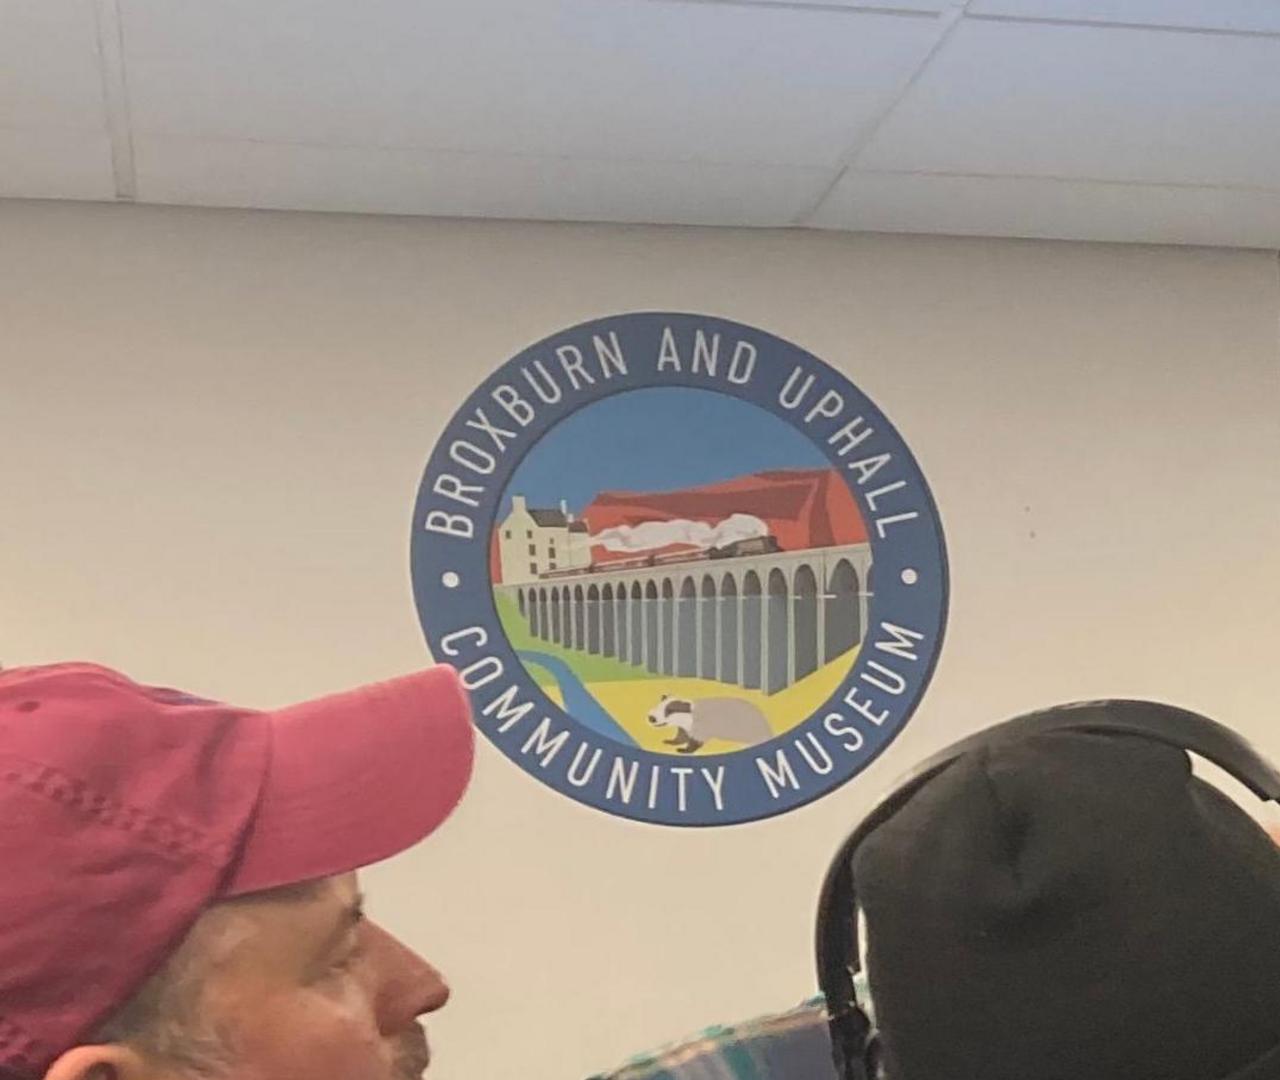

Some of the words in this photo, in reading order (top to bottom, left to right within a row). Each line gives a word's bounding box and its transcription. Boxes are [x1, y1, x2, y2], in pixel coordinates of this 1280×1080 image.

[425, 331, 628, 538] BROXBURN
[657, 327, 758, 385] AND
[779, 366, 918, 539] UPHALL
[441, 625, 726, 811] COMMUNITY
[756, 620, 924, 799] MUSEUM
